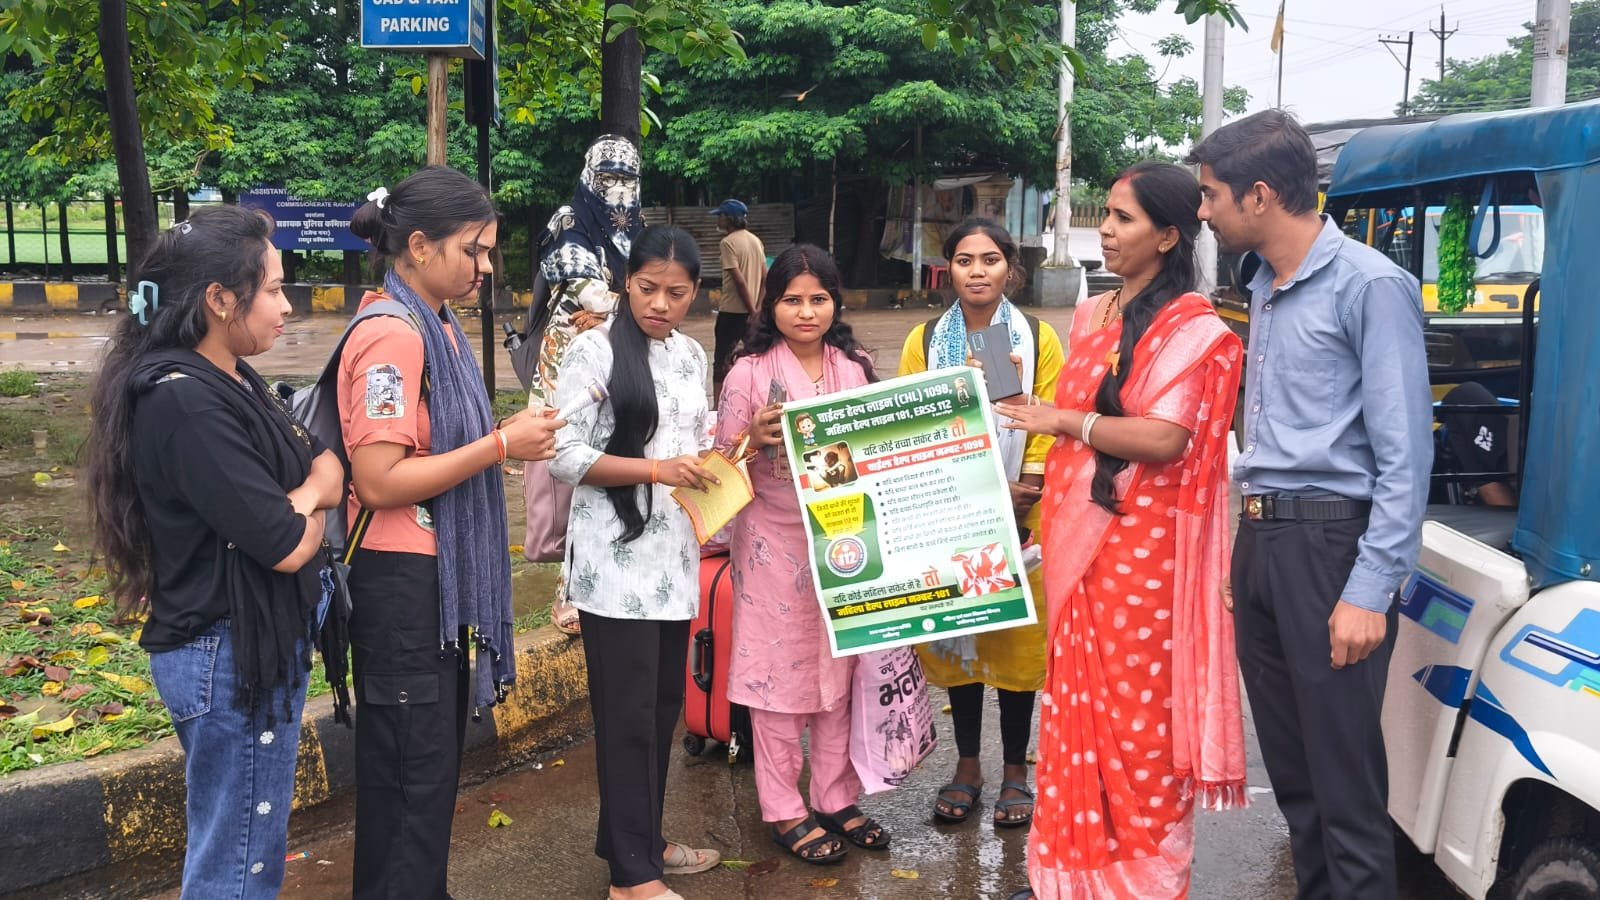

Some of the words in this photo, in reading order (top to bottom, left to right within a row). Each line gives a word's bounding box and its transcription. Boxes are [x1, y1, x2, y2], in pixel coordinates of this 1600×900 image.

[380, 17, 450, 32] PARKING
[865, 397, 893, 412] लाइन
[894, 387, 923, 408] (CHL)
[923, 383, 953, 398] 1098,
[824, 423, 853, 436] महिला
[895, 409, 914, 421] 181,
[913, 403, 937, 417] ERSS
[937, 399, 952, 411] 112
[862, 443, 878, 457] यदि
[877, 439, 894, 452] कोई
[838, 551, 857, 565] 112
[832, 592, 847, 603] यदि
[846, 589, 862, 600] कोई
[861, 587, 887, 598] महिला
[921, 565, 940, 587] तो
[835, 605, 865, 616] महिला
[864, 601, 883, 611] हेल्प
[883, 596, 908, 608] लाइन
